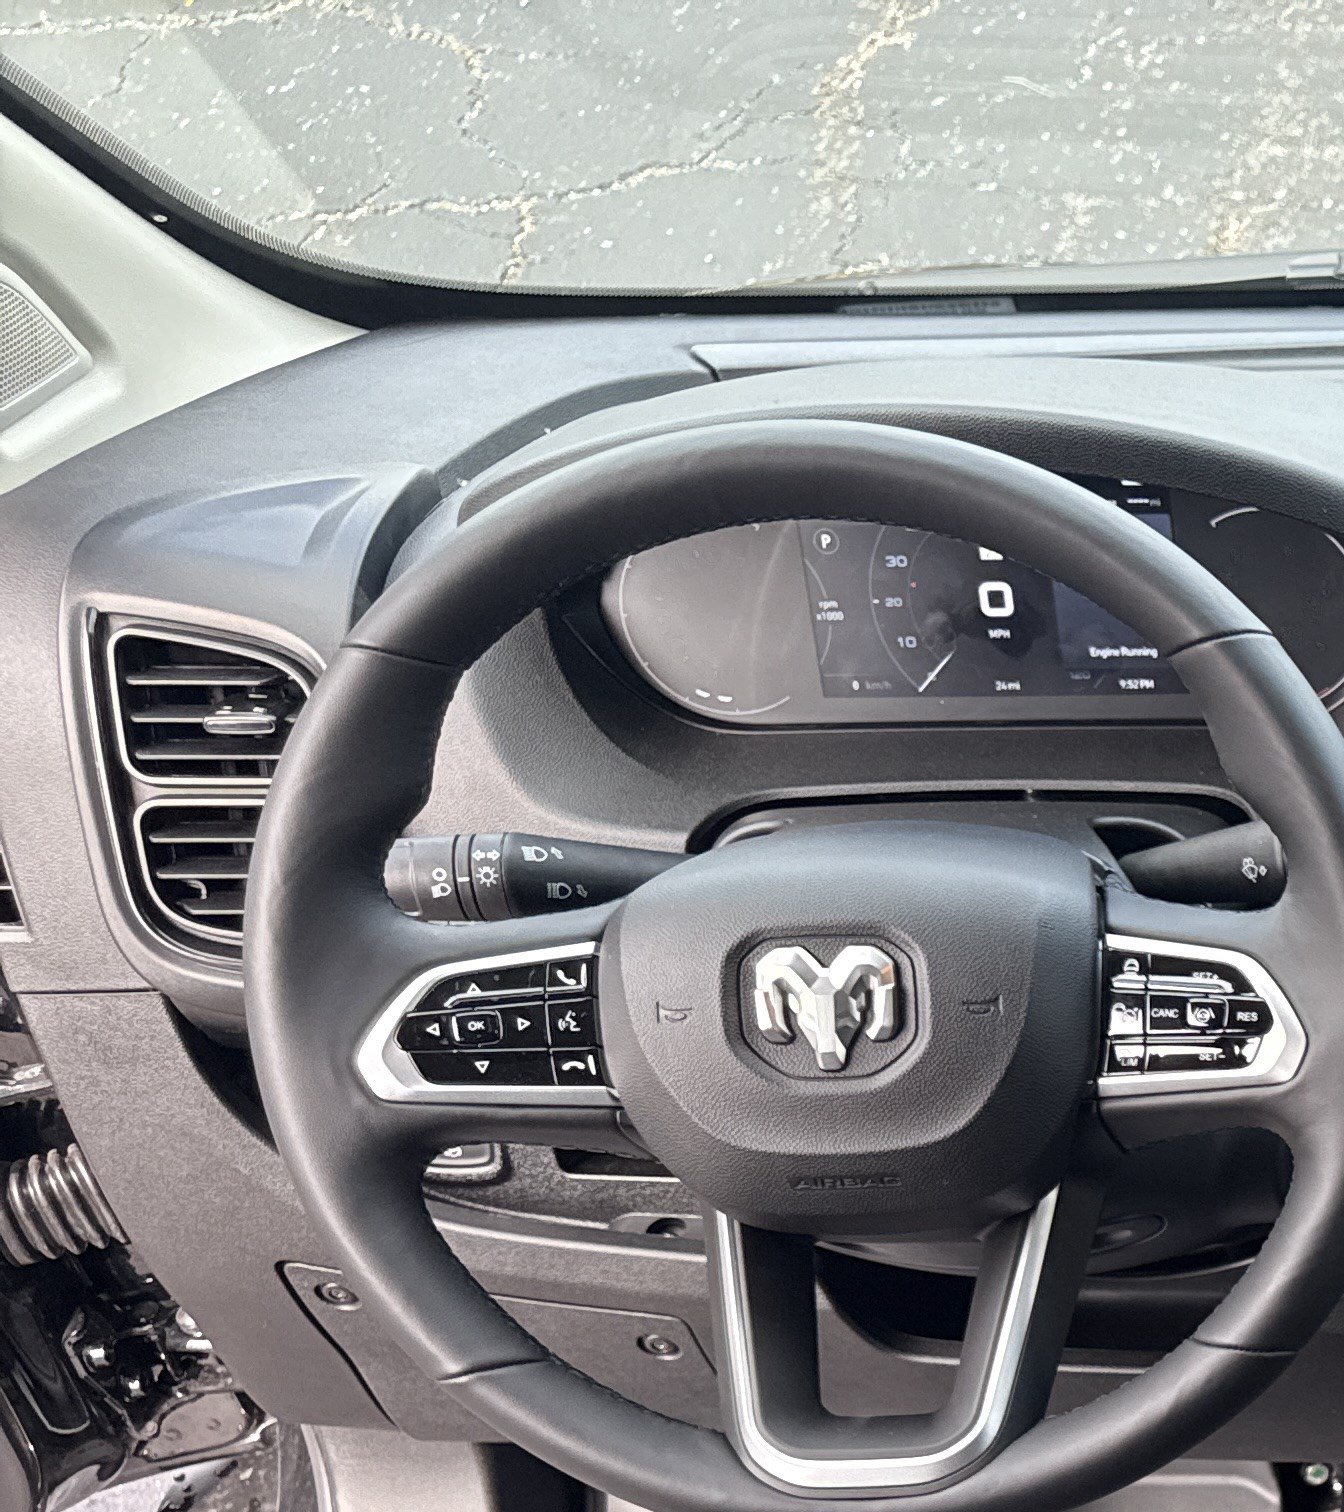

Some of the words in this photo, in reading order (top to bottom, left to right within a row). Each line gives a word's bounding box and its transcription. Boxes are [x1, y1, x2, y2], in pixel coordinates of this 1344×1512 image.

[820, 534, 831, 549] P
[885, 555, 908, 568] 30
[885, 597, 903, 608] 20
[978, 581, 1015, 618] 0
[987, 629, 1012, 640] MPH
[898, 636, 917, 649] 10
[1088, 646, 1121, 659] Engine
[1121, 646, 1159, 659] Running
[1118, 678, 1139, 690] 9:52
[1139, 678, 1155, 690] PM
[1151, 1007, 1180, 1019] CANC
[1236, 1011, 1260, 1022] RES
[467, 1020, 486, 1032] OK
